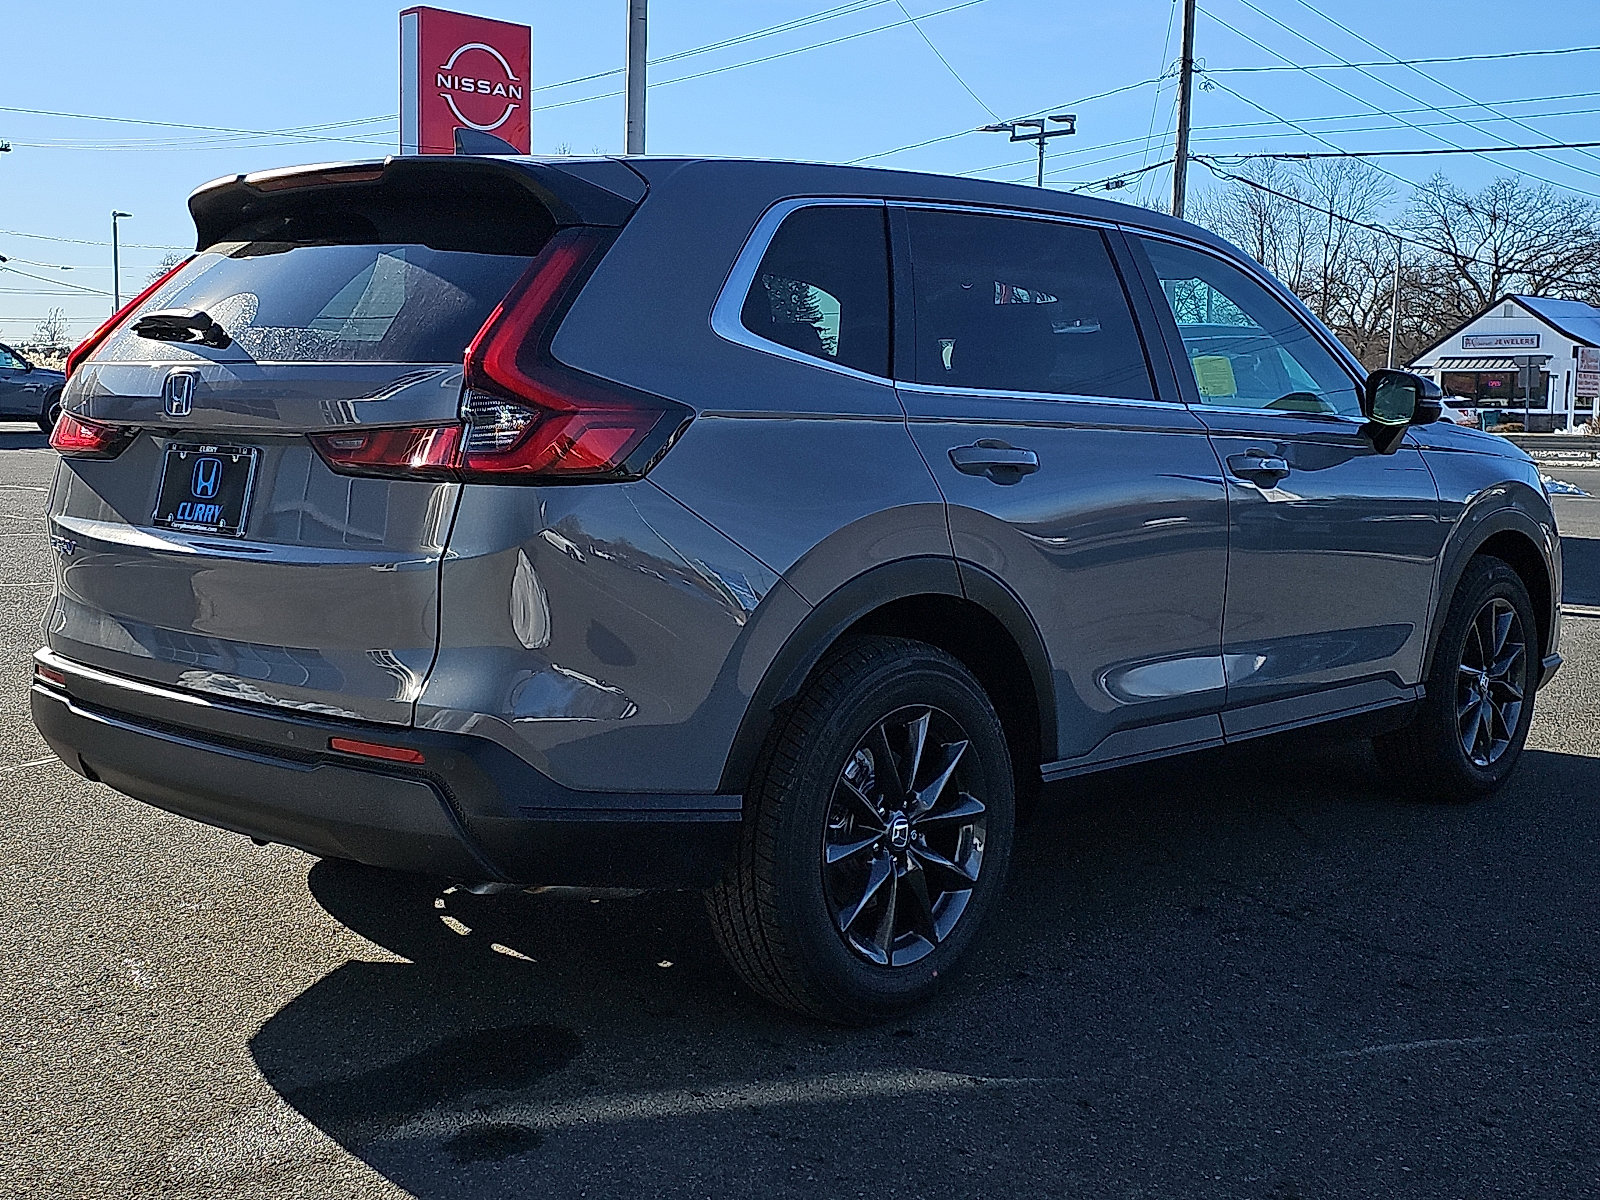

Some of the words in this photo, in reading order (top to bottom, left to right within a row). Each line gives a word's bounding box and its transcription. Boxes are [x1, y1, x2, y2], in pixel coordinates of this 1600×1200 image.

[437, 73, 522, 100] NISSAN
[1494, 338, 1535, 346] JEWELERS
[177, 502, 224, 523] CURRY
